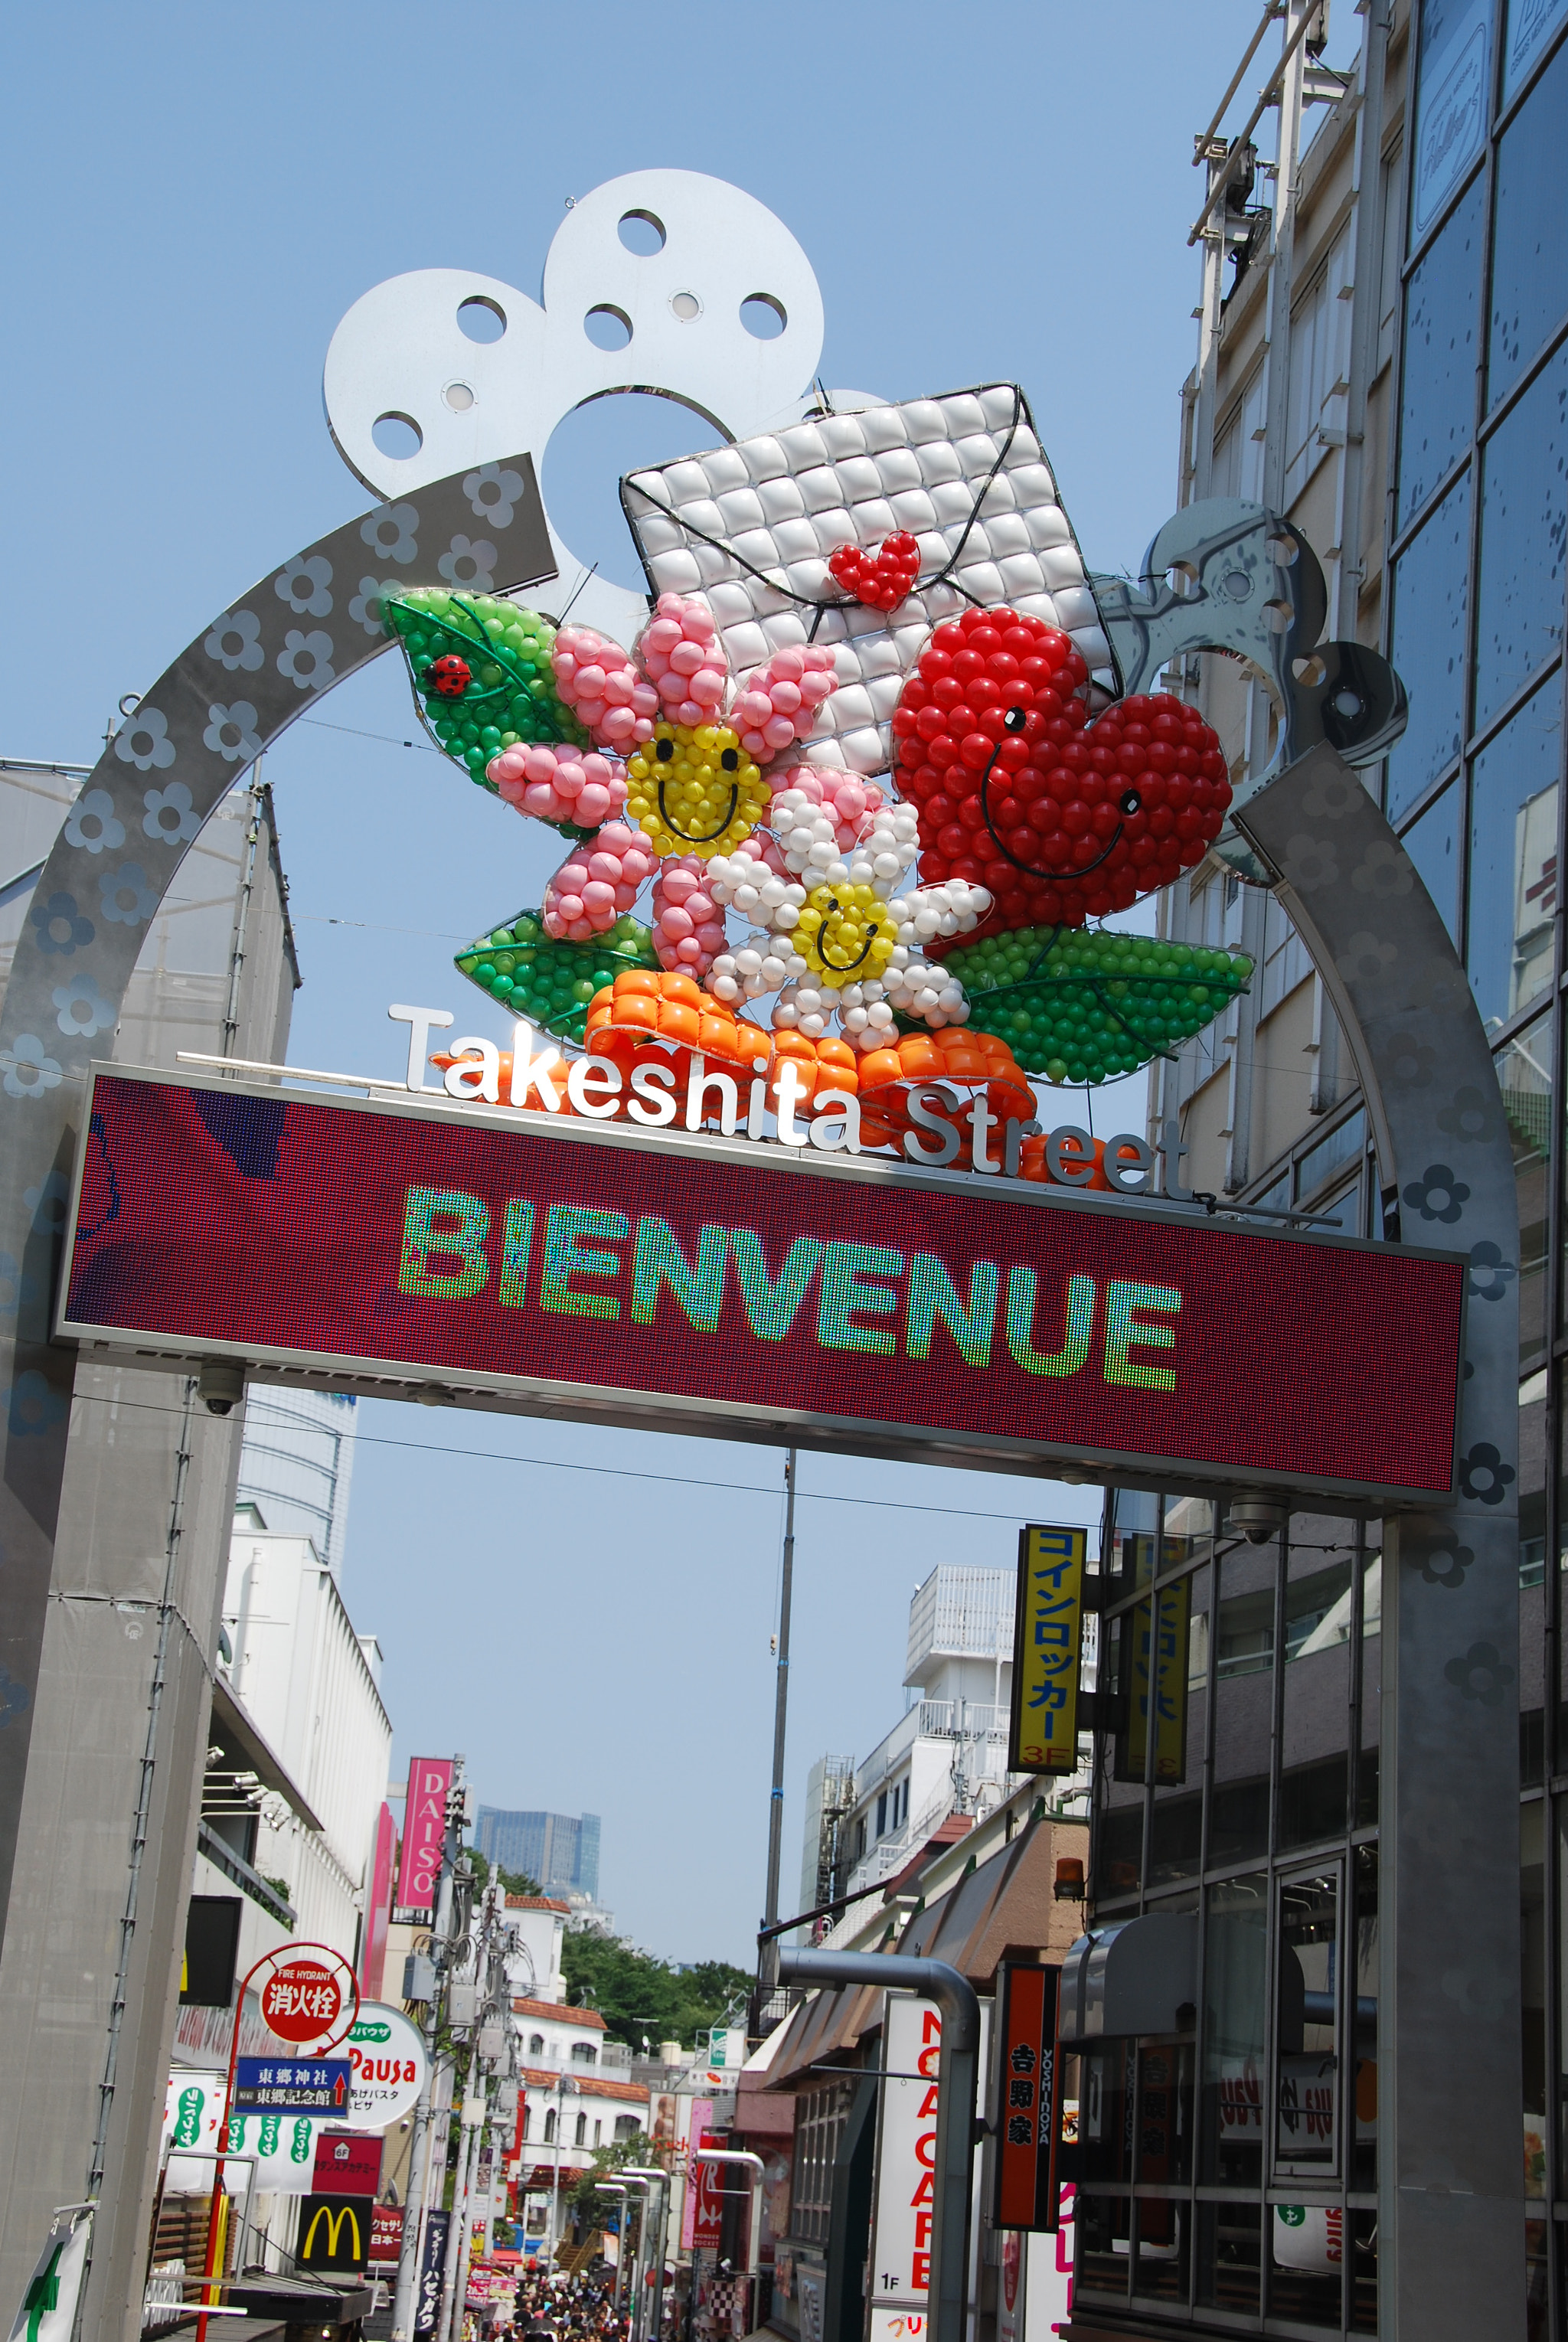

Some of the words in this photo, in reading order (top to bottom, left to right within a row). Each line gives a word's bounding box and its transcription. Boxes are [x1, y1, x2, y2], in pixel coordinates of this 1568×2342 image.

[388, 1003, 861, 1155] Takeshita
[903, 1083, 1193, 1200] Street
[398, 1184, 1184, 1392] BIENVENUE
[1027, 1533, 1076, 1739] コインロッカー
[1023, 1746, 1070, 1764] 3F
[413, 1773, 444, 1893] DAISO
[278, 1968, 295, 1979] FIRE
[296, 1970, 333, 1981] HYDRANT
[267, 1983, 338, 2019] 消火栓
[257, 2068, 328, 2086] 東郷神社
[348, 2047, 416, 2086] Pausa
[256, 2088, 331, 2106] 東郷記念館
[1008, 2043, 1037, 2145] 吉野家
[1039, 2049, 1053, 2144] YOSHINOYA
[336, 2148, 348, 2157] 6F
[418, 2270, 440, 2330] ハセガワ
[881, 2273, 900, 2290] 1F
[887, 2314, 927, 2339] プリ
